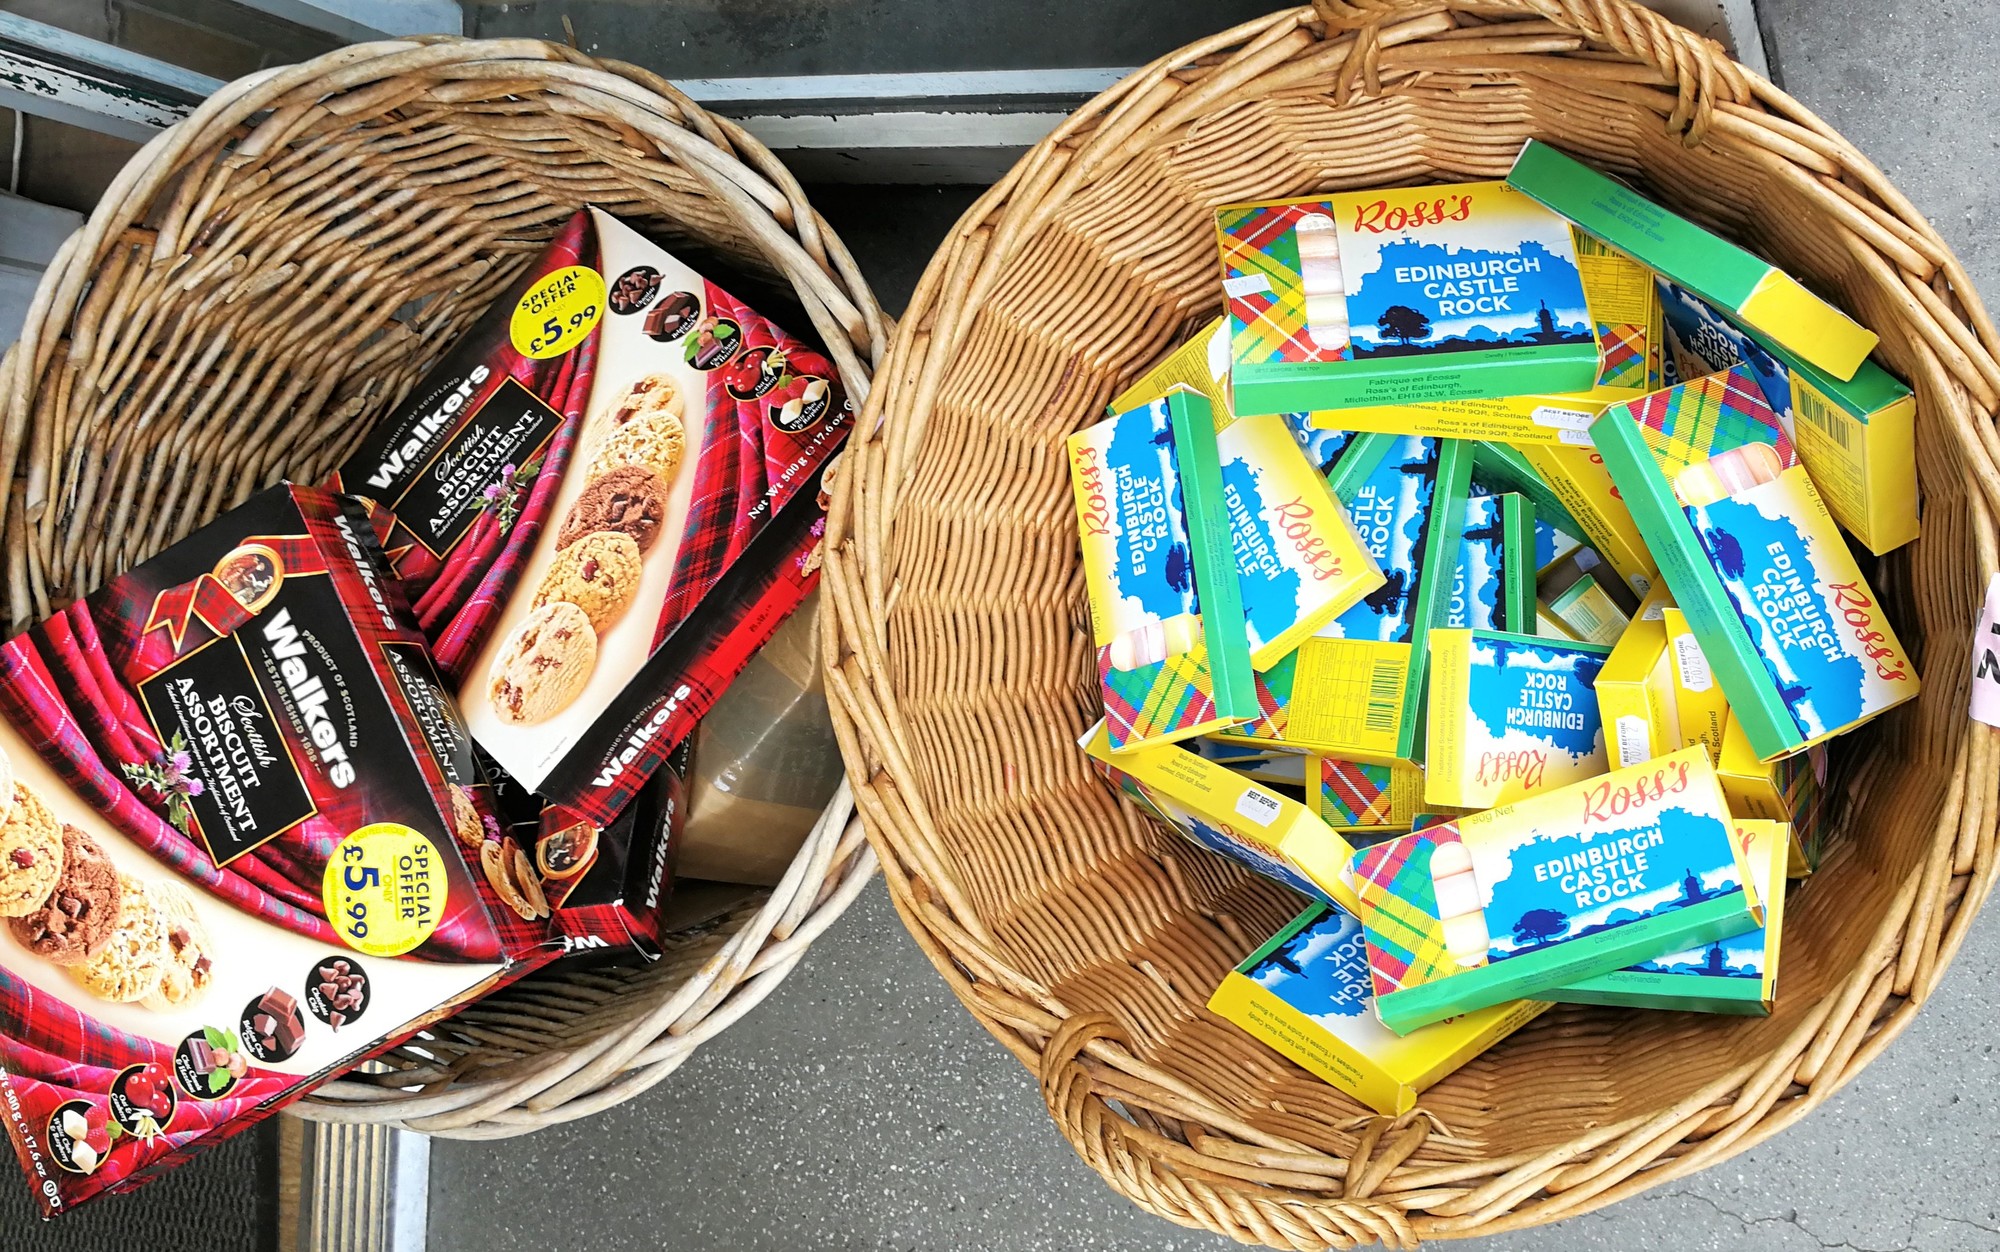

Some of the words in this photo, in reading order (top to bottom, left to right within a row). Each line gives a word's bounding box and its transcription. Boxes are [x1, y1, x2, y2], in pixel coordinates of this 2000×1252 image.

[1354, 196, 1473, 234] Ross's
[522, 270, 580, 310] SPECIAL
[531, 283, 576, 314] OFFER
[1394, 257, 1542, 283] EDINBURGH
[1423, 276, 1520, 299] CASTLE
[530, 305, 596, 354] £5.99
[1439, 296, 1511, 317] ROCK
[1698, 317, 1738, 356] ROCK
[380, 421, 409, 460] PRODUCT
[408, 408, 419, 422] OF
[419, 377, 460, 412] SCOTLAND
[1366, 386, 1397, 394] Ross's
[366, 364, 490, 490] Walkers
[1438, 418, 1468, 426] Ross's
[1462, 428, 1486, 436] EH20
[429, 409, 533, 533] ASSORTMENT
[434, 424, 486, 482] Scottish
[437, 425, 502, 499] BISCUIT
[747, 502, 770, 520] Net
[765, 479, 784, 500] Wt
[781, 463, 799, 483] 500
[812, 424, 835, 446] 17.6
[832, 412, 846, 427] oz
[1076, 447, 1110, 536] Ross's
[1118, 464, 1146, 576] EDINBURGH
[1133, 476, 1158, 552] CASTLE
[1148, 478, 1168, 539] ROCK
[1553, 476, 1576, 500] Ross's
[1573, 499, 1582, 508] of
[1564, 479, 1583, 499] Made
[1586, 506, 1615, 537] Scotland
[1814, 498, 1829, 518] Net
[1224, 484, 1281, 580] EDINBURGH
[1274, 496, 1342, 581] Ross's
[1369, 496, 1395, 559] ROCK
[1593, 534, 1623, 566] Scotland
[334, 516, 396, 630] Walkers
[1448, 564, 1464, 627] ROCK
[1766, 542, 1842, 664] EDINBURGH
[1751, 583, 1796, 650] ROCK
[1762, 568, 1816, 652] CASTLE
[1828, 582, 1908, 683] Ross's
[1524, 671, 1567, 690] ROCK
[1678, 640, 1688, 665] BEFORE
[263, 606, 356, 788] Walkers
[264, 658, 304, 734] ESTABLISHED
[302, 630, 338, 672] PRODUCT
[334, 674, 346, 688] OF
[341, 689, 358, 748] SCOTLAND
[390, 649, 460, 780] ASSORTMENT
[416, 676, 458, 752] BISCUIT
[1506, 707, 1584, 730] EDINBURGH
[1519, 689, 1574, 710] CASTLE
[176, 678, 257, 831] ASSORTMENT
[208, 694, 260, 788] BISCUIT
[229, 695, 277, 768] Scottish
[592, 685, 691, 788] Walkers
[623, 722, 631, 734] OF
[1620, 722, 1628, 745] BEFORE
[1708, 711, 1720, 748] Scotland
[1476, 748, 1548, 789] Ross's
[1583, 761, 1690, 824] Ross's
[1472, 811, 1492, 824] 90g
[1494, 805, 1515, 817] Net
[646, 798, 674, 908] Walkers
[1534, 828, 1664, 882] EDINBURGH
[1560, 854, 1650, 893] CASTLE
[344, 845, 379, 938] £5.99
[383, 874, 393, 902] ONLY
[400, 856, 414, 918] OFFER
[415, 845, 430, 928] SPECIAL
[1575, 878, 1646, 908] ROCK
[118, 1094, 128, 1108] Oat
[5, 1086, 20, 1111] 500
[24, 1135, 42, 1161] 17.6
[34, 1162, 47, 1178] oz
[53, 1117, 64, 1137] White
[61, 1136, 72, 1154] Choc
